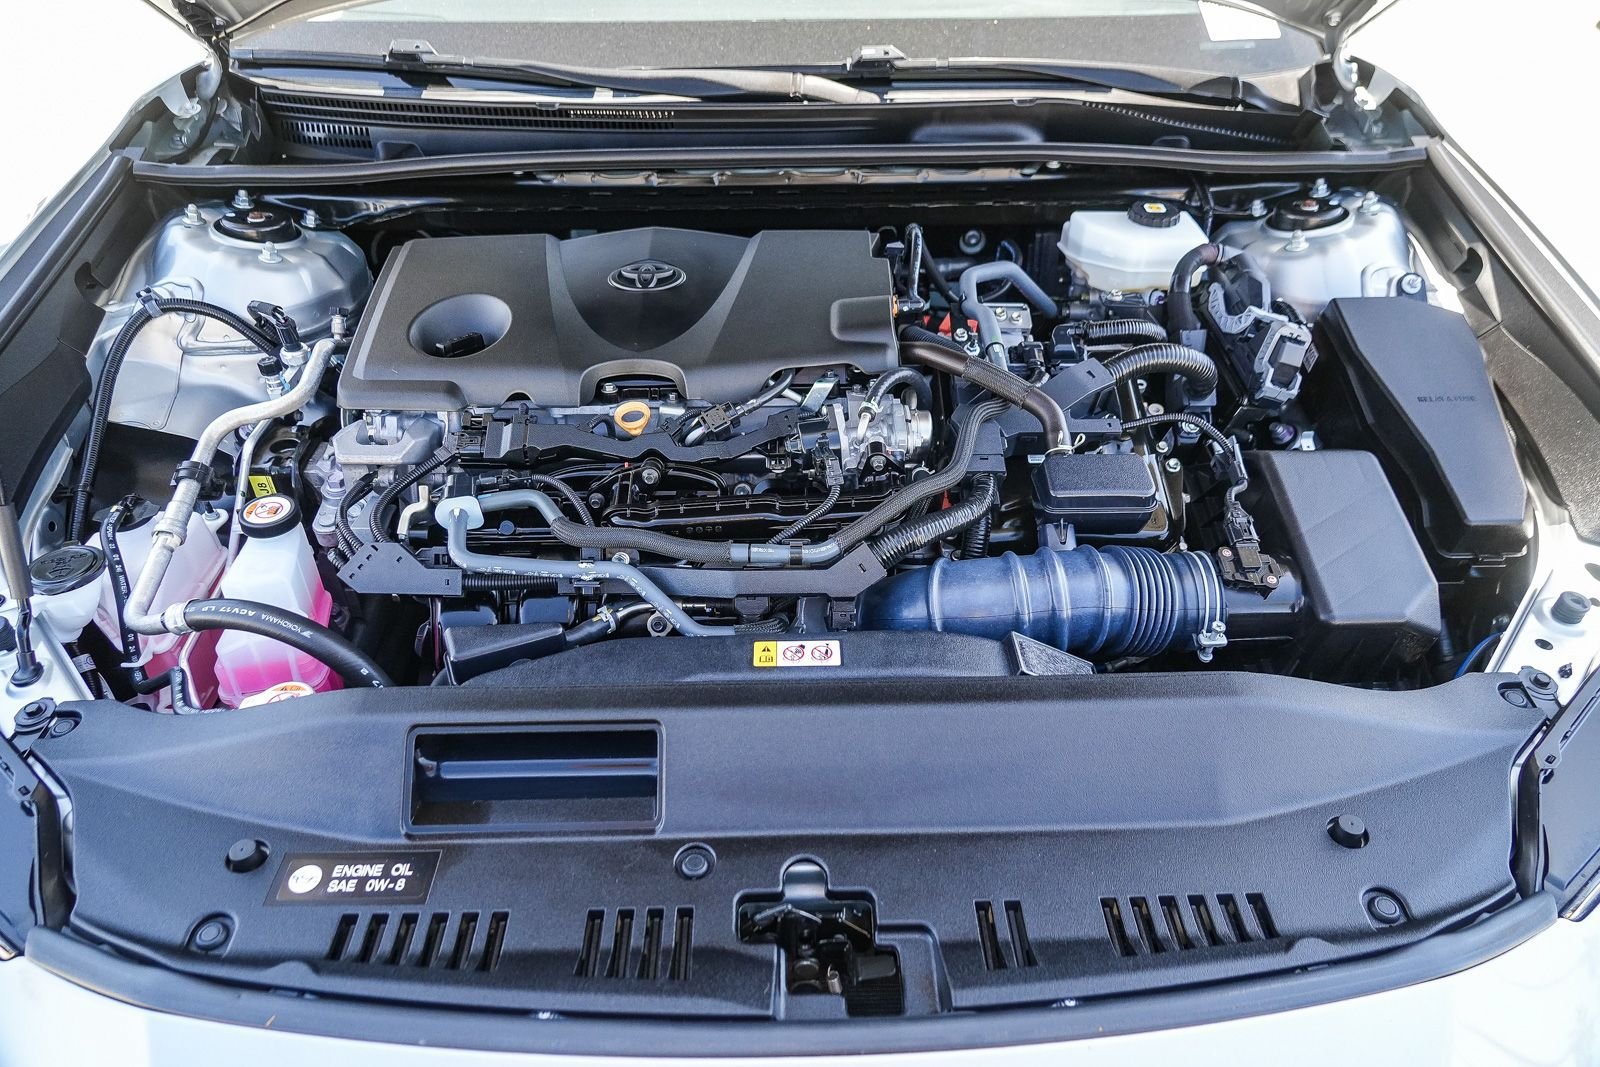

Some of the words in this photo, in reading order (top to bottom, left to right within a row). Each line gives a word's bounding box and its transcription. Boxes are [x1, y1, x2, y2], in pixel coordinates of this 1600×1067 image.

[257, 482, 270, 494] J8
[119, 574, 128, 595] WATER
[219, 606, 257, 617] ACV17
[261, 613, 303, 633] YOKOHAMA
[331, 864, 385, 878] ENGINE
[390, 862, 414, 877] OIL
[326, 879, 358, 893] SAE
[365, 878, 406, 892] 0W-8
